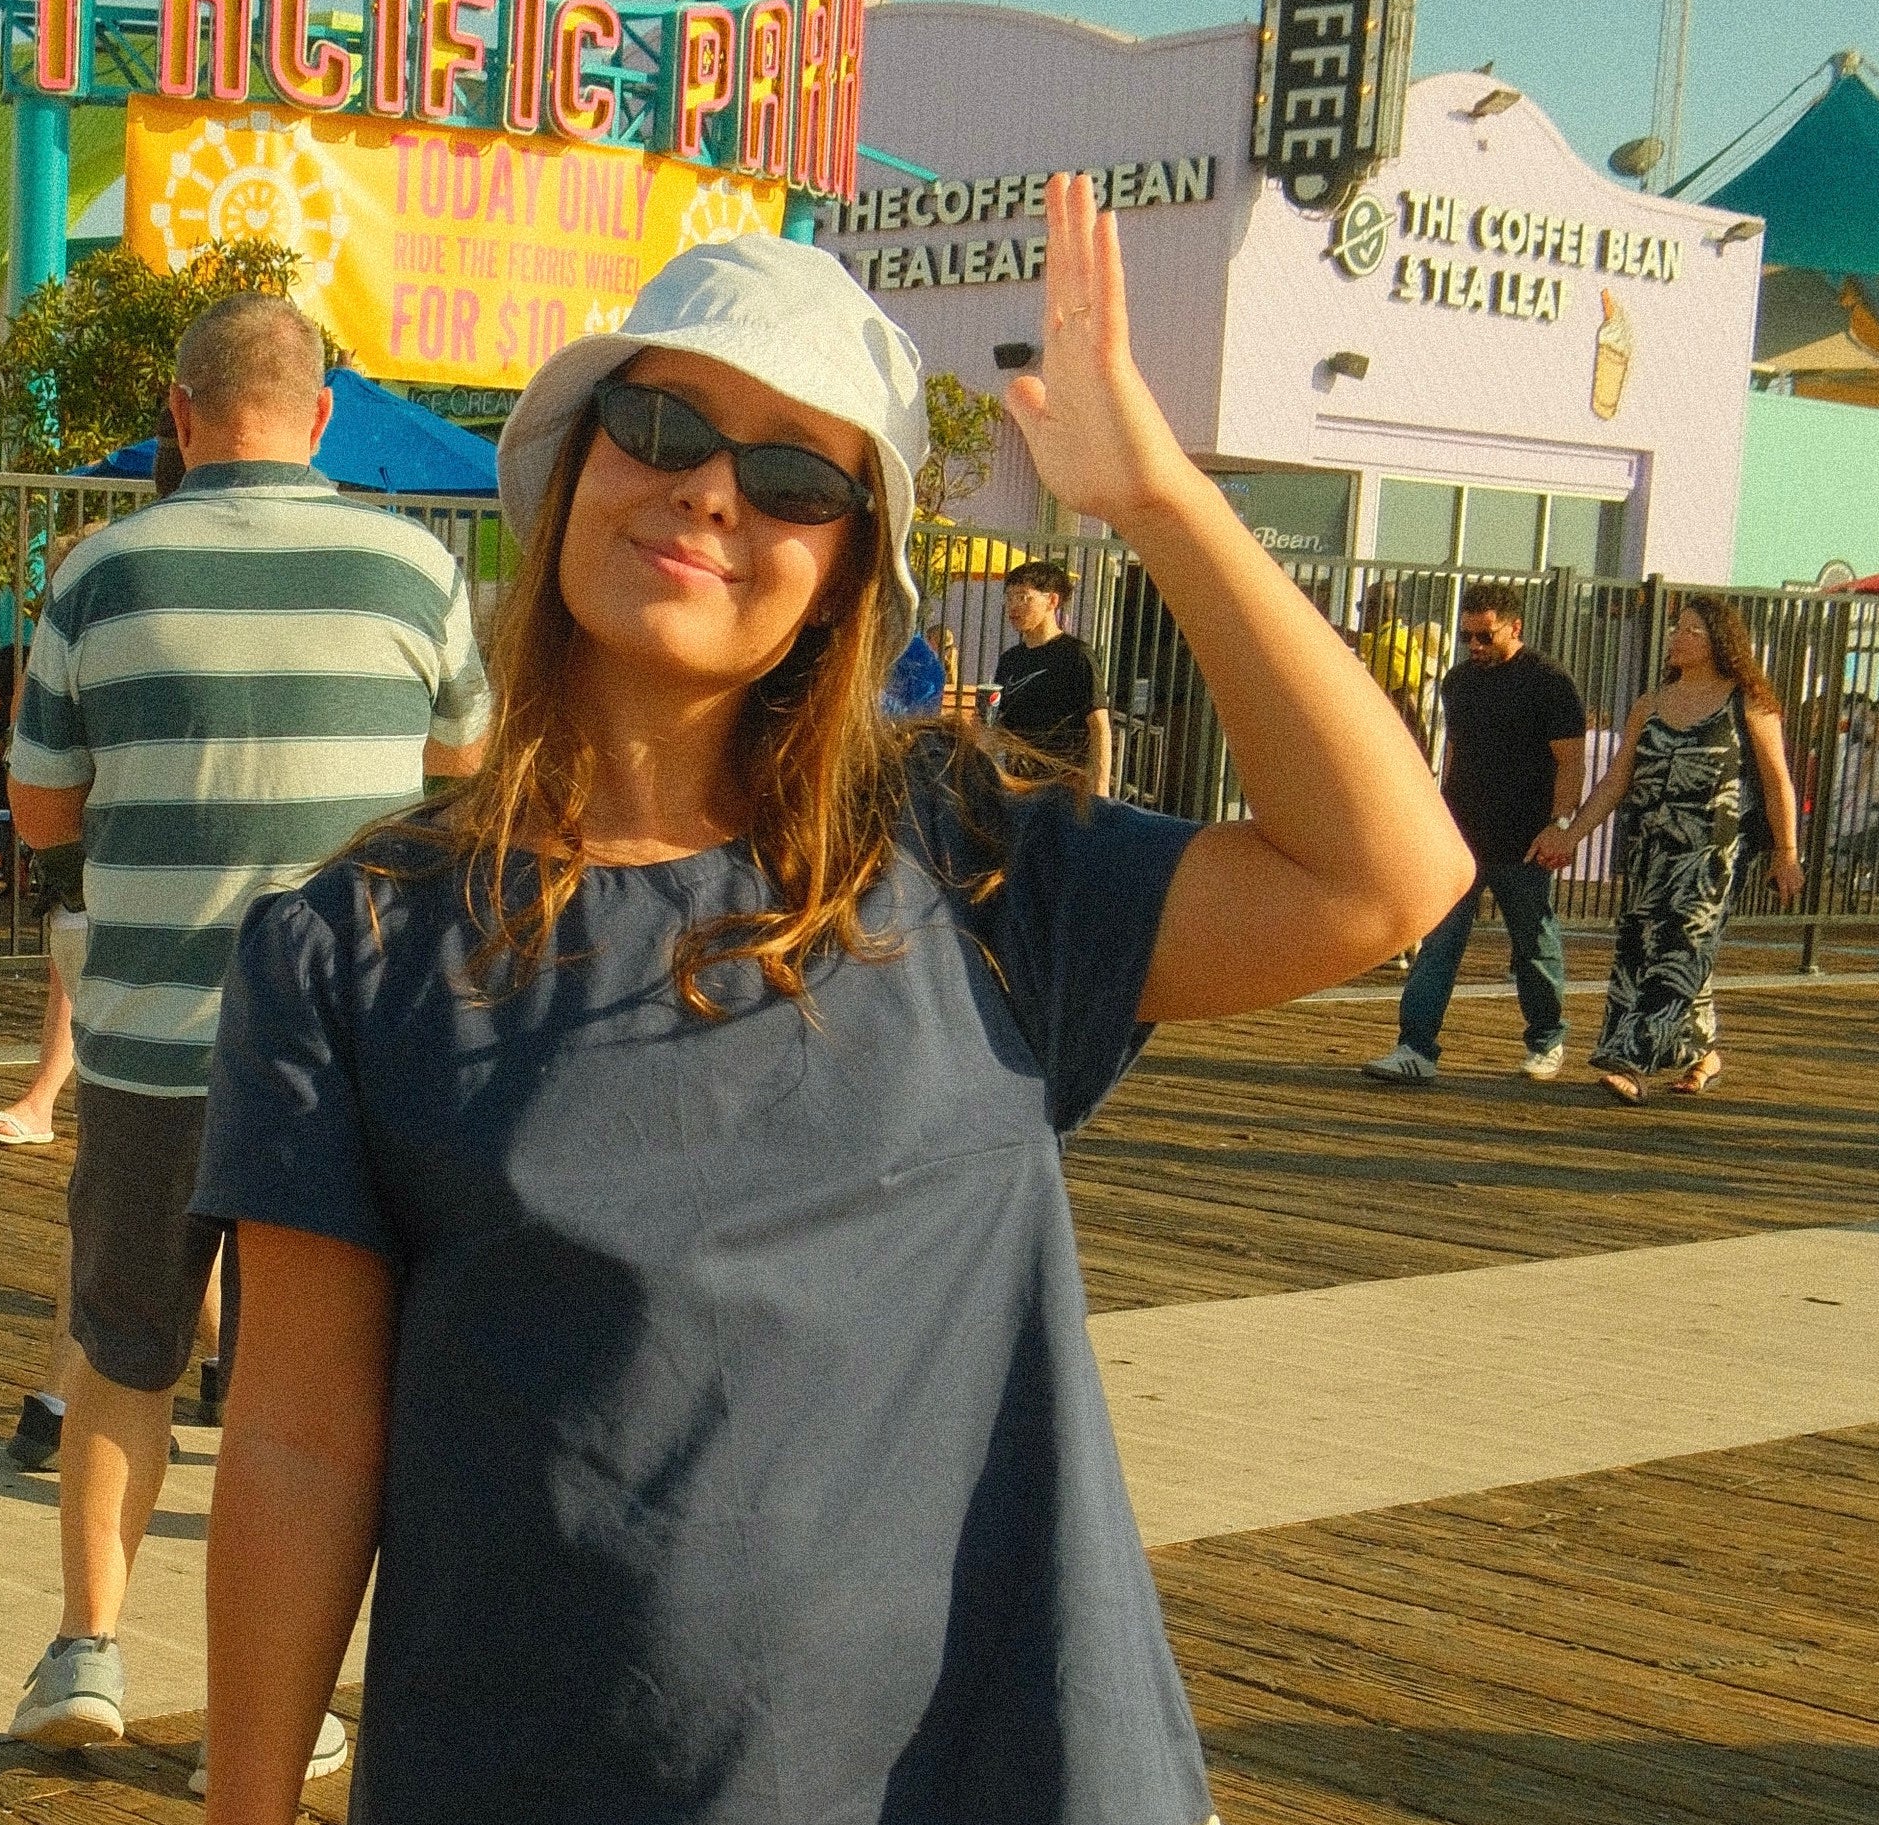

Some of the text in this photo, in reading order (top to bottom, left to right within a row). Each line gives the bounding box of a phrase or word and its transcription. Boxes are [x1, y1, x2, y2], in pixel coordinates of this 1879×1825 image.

[391, 133, 656, 242] TODAY ONLY
[909, 172, 1048, 227] COFFE
[393, 231, 446, 275] RIDE
[457, 236, 501, 280] THE
[505, 241, 579, 289] FERRIS
[1408, 188, 1683, 281] THE COFFEE BEAN
[856, 244, 935, 292] TEA
[1427, 257, 1488, 309] TEA
[1498, 270, 1573, 322] LEAF
[390, 281, 481, 364] FOR
[495, 289, 567, 372] $10
[1252, 526, 1323, 553] Bean
